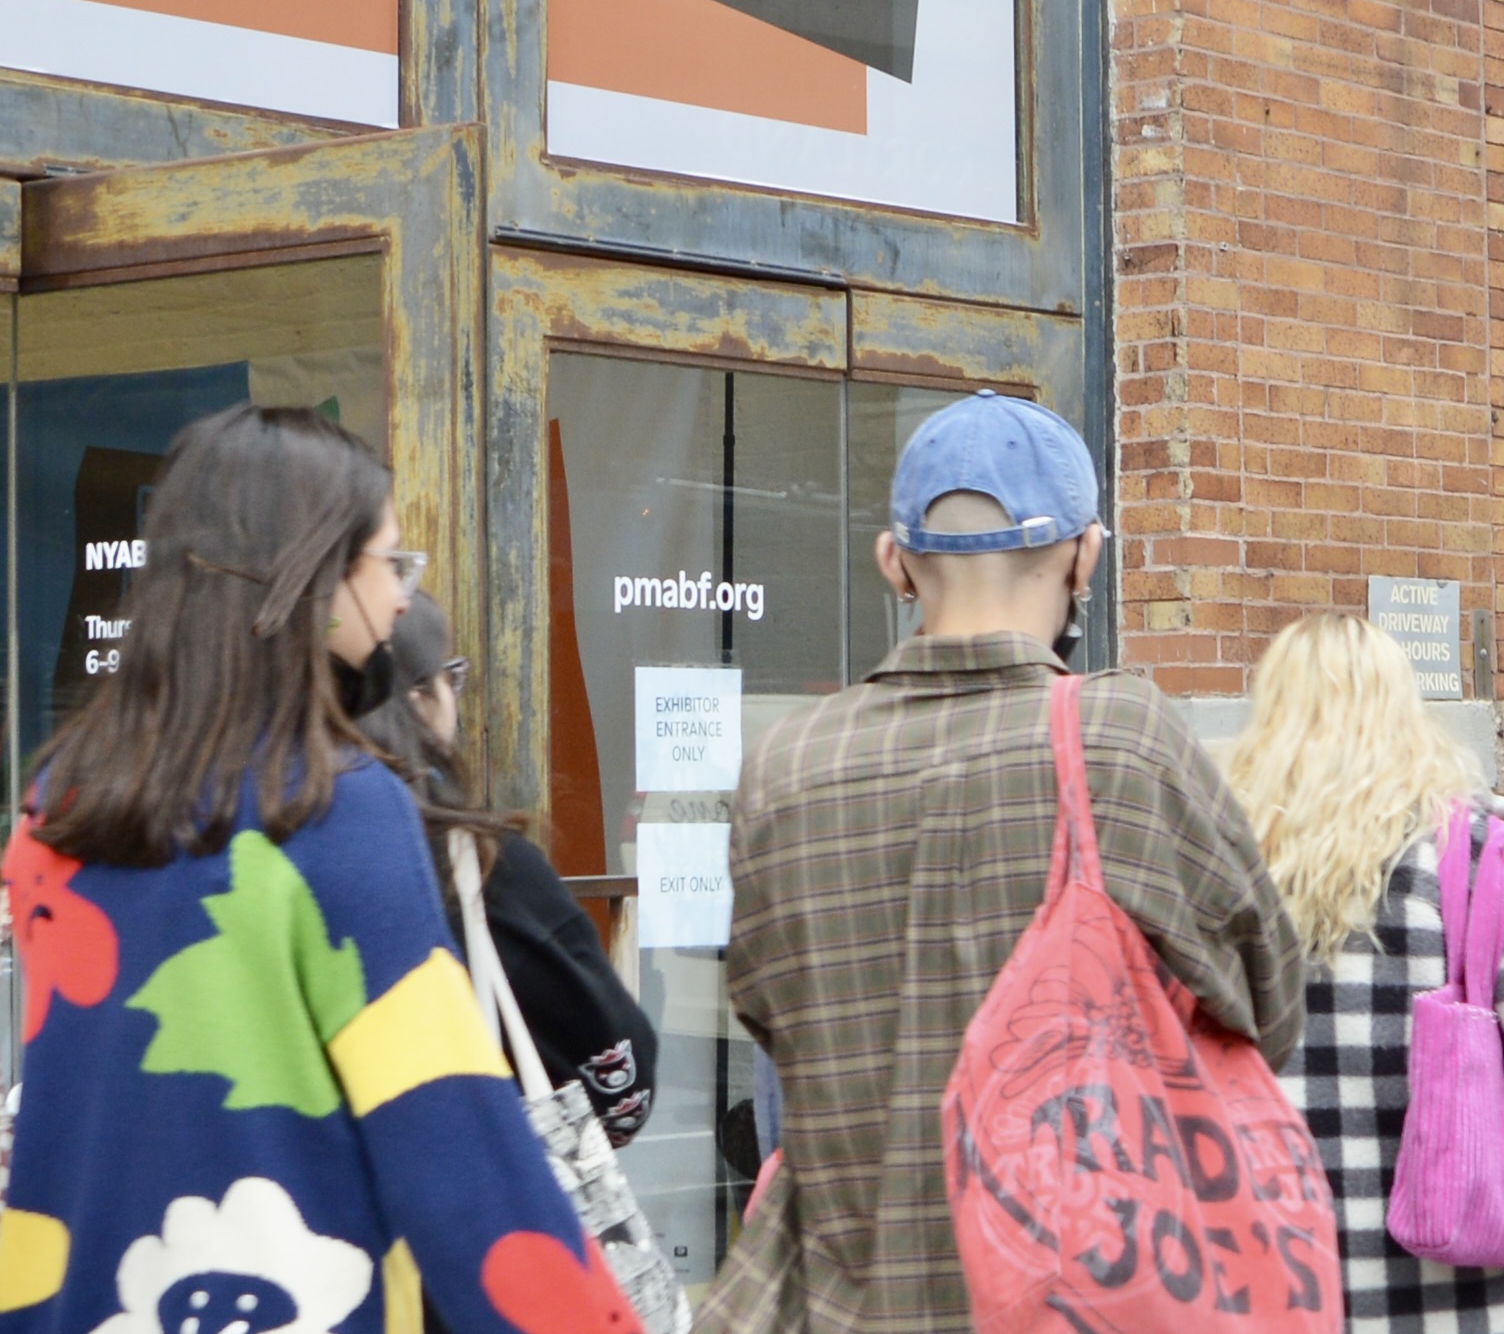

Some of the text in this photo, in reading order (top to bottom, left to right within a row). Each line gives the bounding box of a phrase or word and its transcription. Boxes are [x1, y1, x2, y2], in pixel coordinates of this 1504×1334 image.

[85, 539, 147, 570] NYAB
[613, 570, 765, 621] pmabf.org
[1390, 584, 1439, 605] ACTIVE
[1378, 612, 1449, 634] DRIVEWAY
[1401, 641, 1450, 661] HOURS
[1416, 672, 1459, 692] RKING
[655, 696, 720, 714] EXHIBITOR
[656, 720, 723, 738] ENTRANCE
[672, 745, 705, 762] ONLY
[659, 875, 723, 893] EXIT ONLY
[1073, 1199, 1323, 1314] JOE'S
